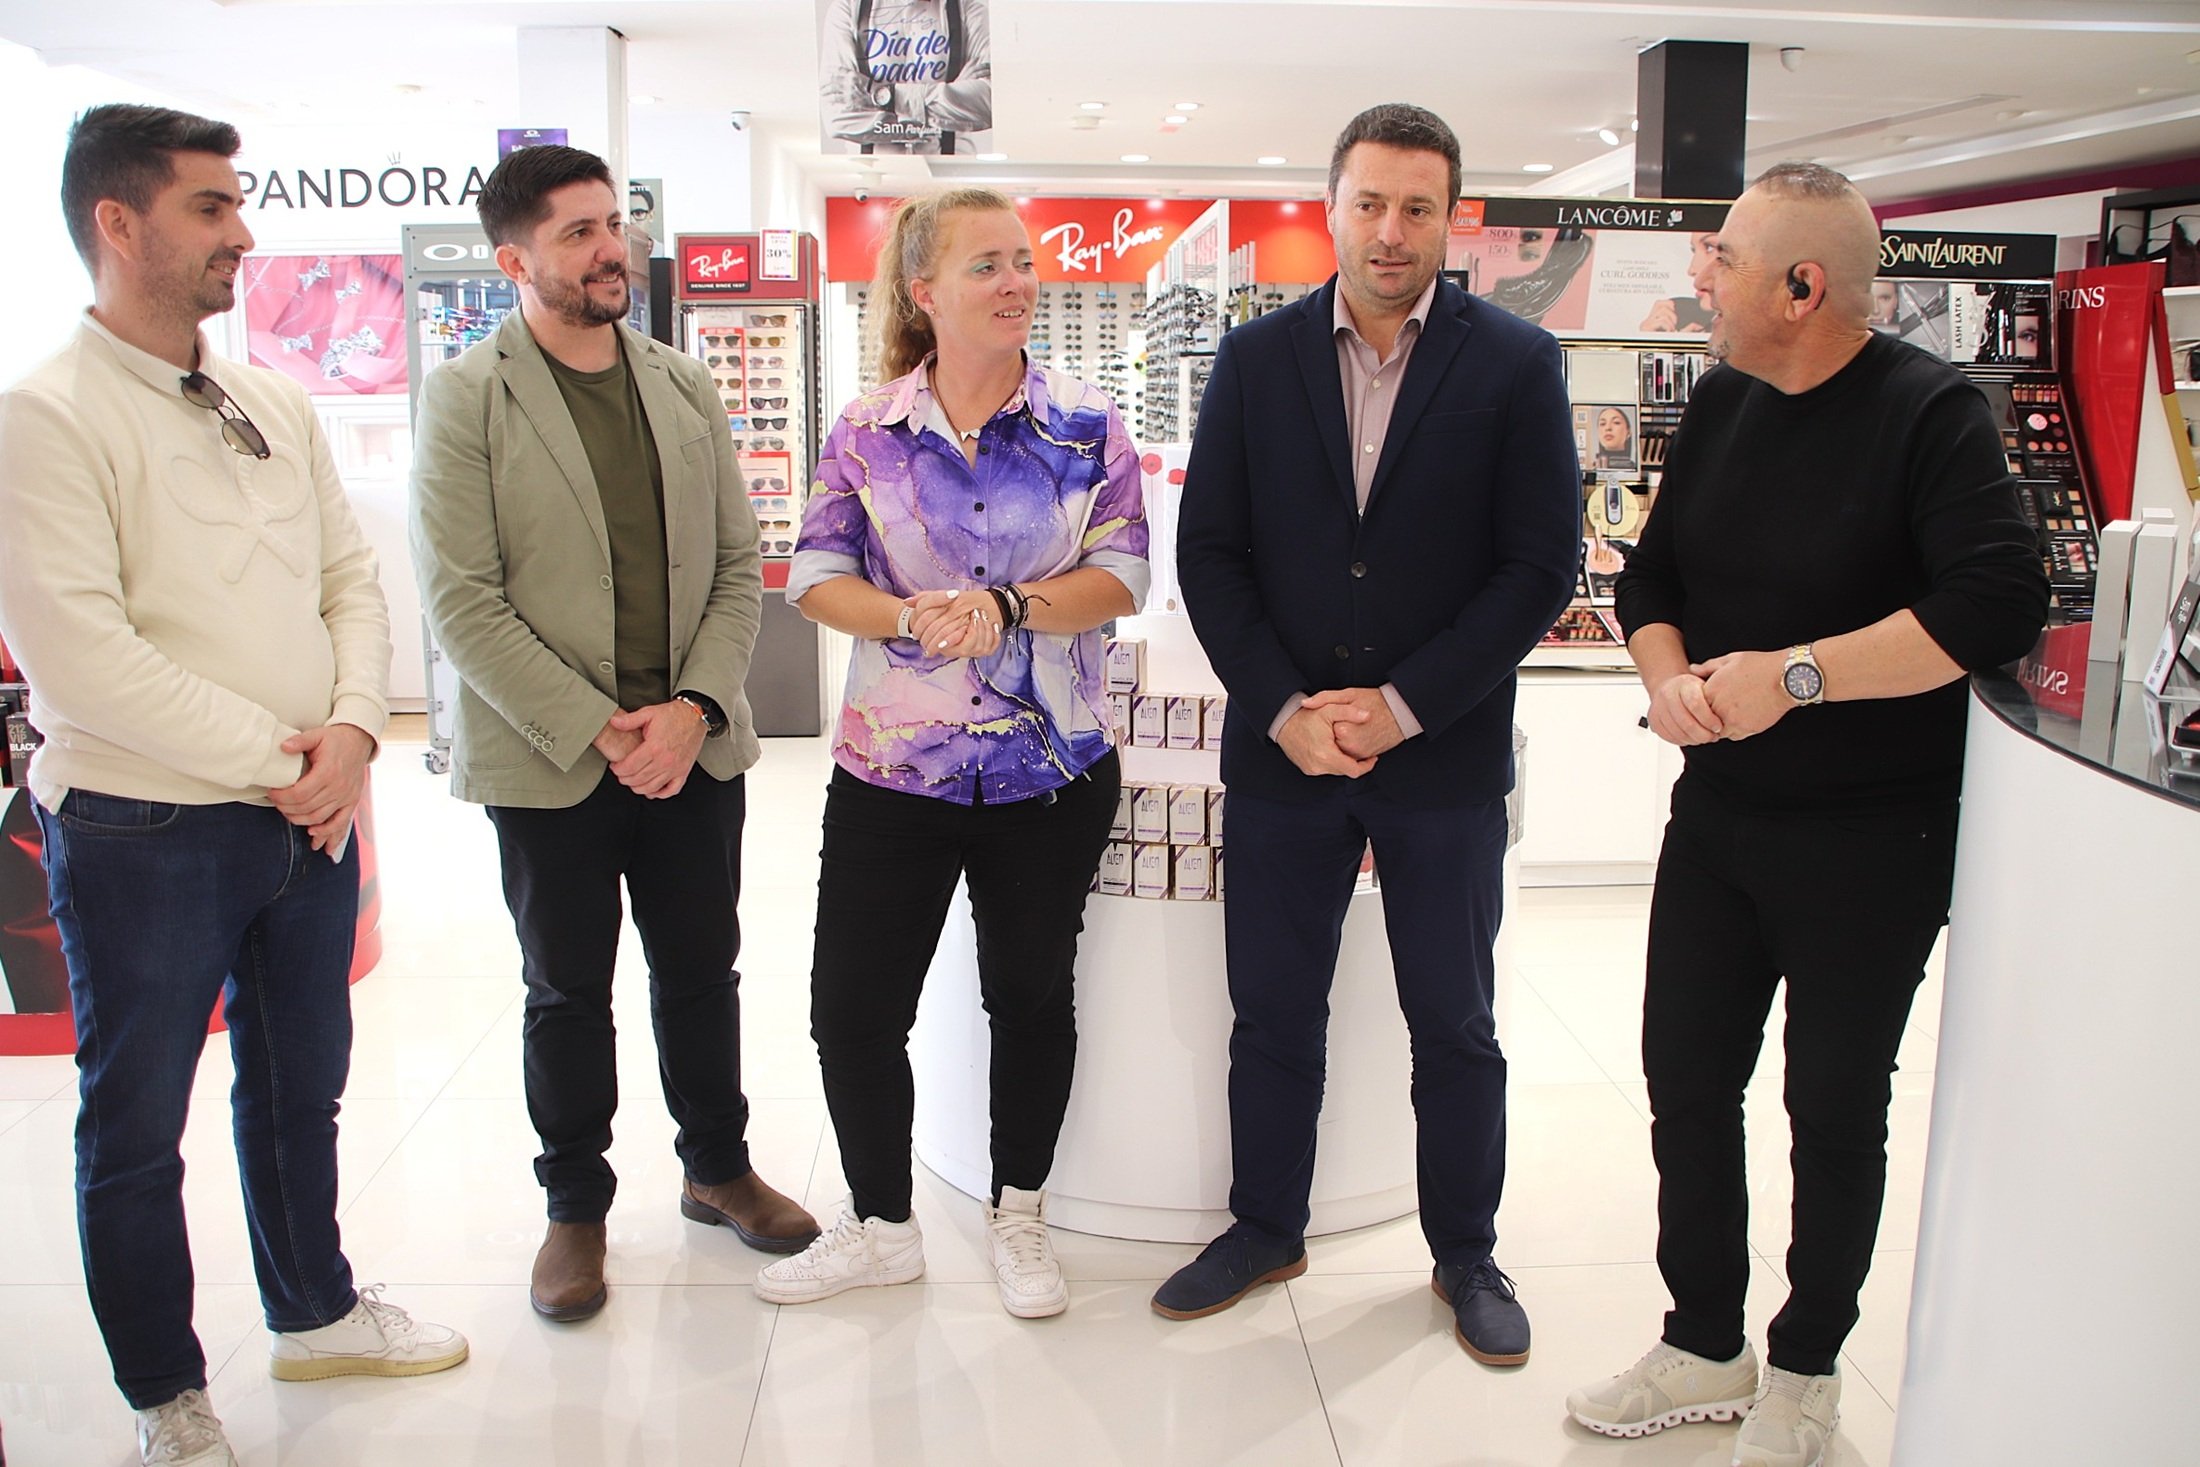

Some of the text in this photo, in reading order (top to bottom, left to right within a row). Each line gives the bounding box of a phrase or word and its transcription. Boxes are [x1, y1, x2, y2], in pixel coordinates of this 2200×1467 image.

[863, 29, 912, 59] Día
[868, 57, 946, 88] padre
[873, 121, 904, 134] Sam
[236, 166, 486, 209] PANDORA
[1557, 206, 1661, 226] LANCÔME
[2058, 286, 2105, 310] RINS
[10, 743, 37, 751] BLACK
